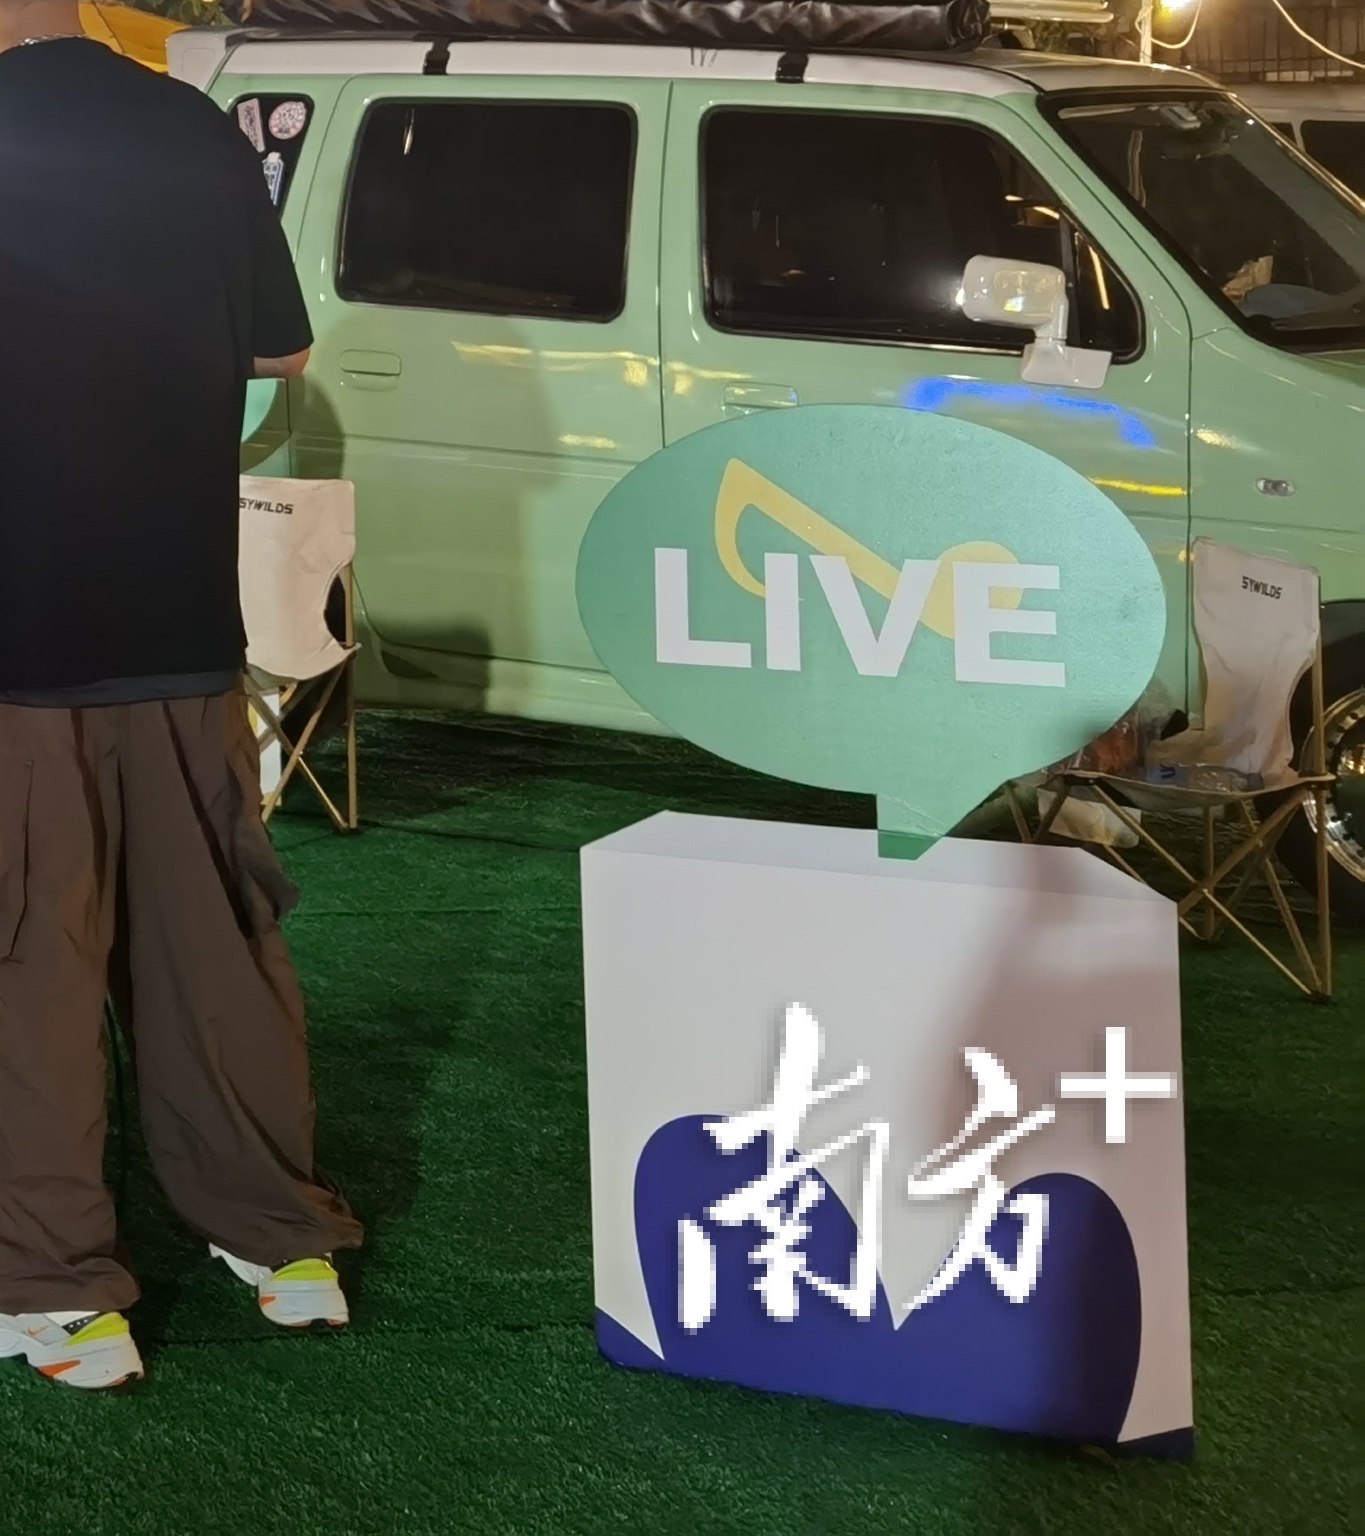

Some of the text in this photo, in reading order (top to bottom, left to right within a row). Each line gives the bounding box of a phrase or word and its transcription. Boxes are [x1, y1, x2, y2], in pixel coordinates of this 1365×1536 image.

[239, 497, 295, 515] SYWILDS
[1241, 574, 1284, 600] SYWILDS
[654, 547, 1067, 689] LIVE
